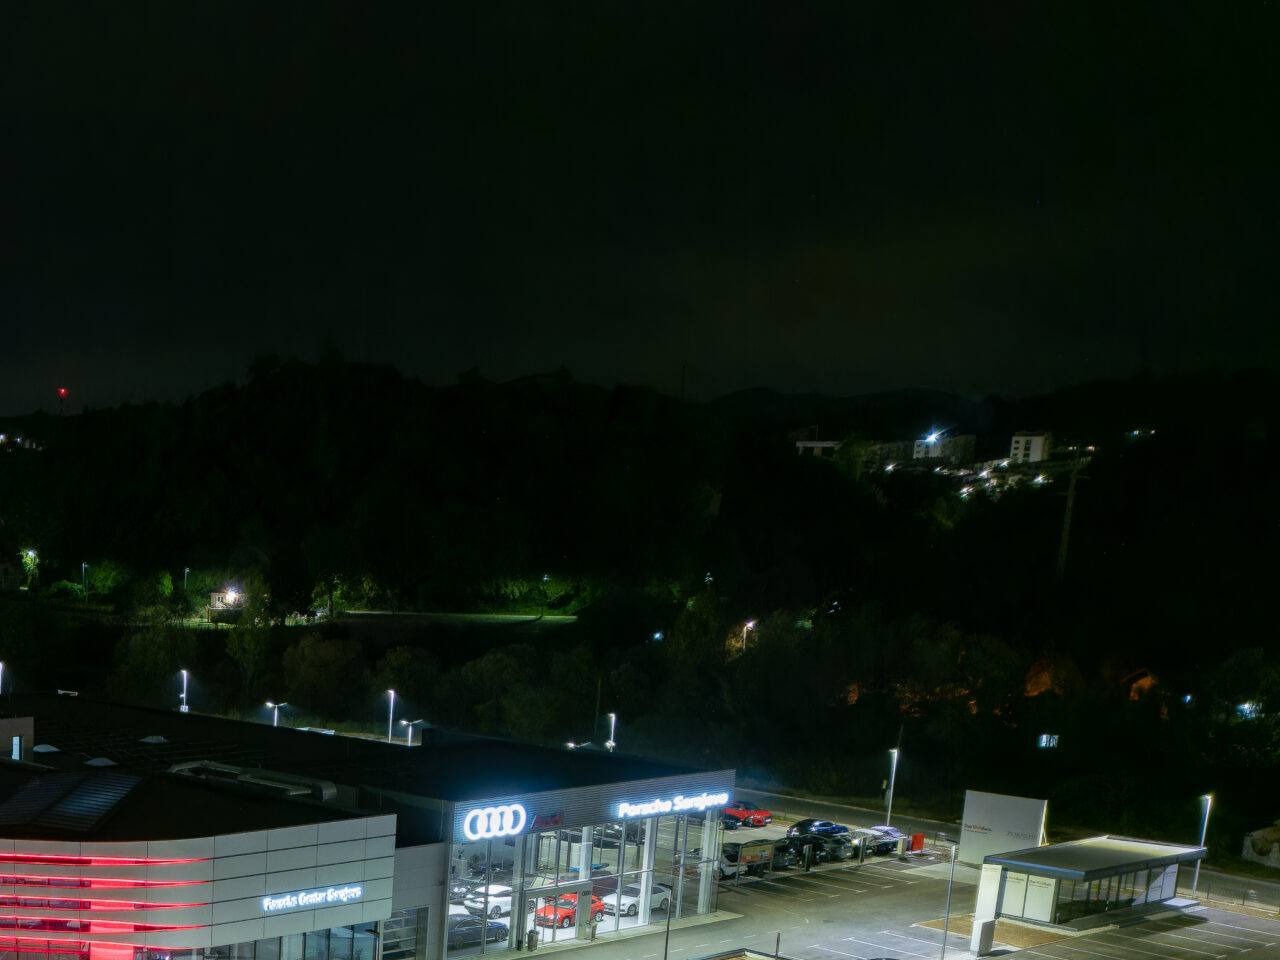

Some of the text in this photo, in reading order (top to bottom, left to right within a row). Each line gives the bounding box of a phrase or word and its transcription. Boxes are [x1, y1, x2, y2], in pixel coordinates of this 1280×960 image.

[618, 792, 729, 818] Porsche Sarajevo
[531, 811, 565, 829] Audi
